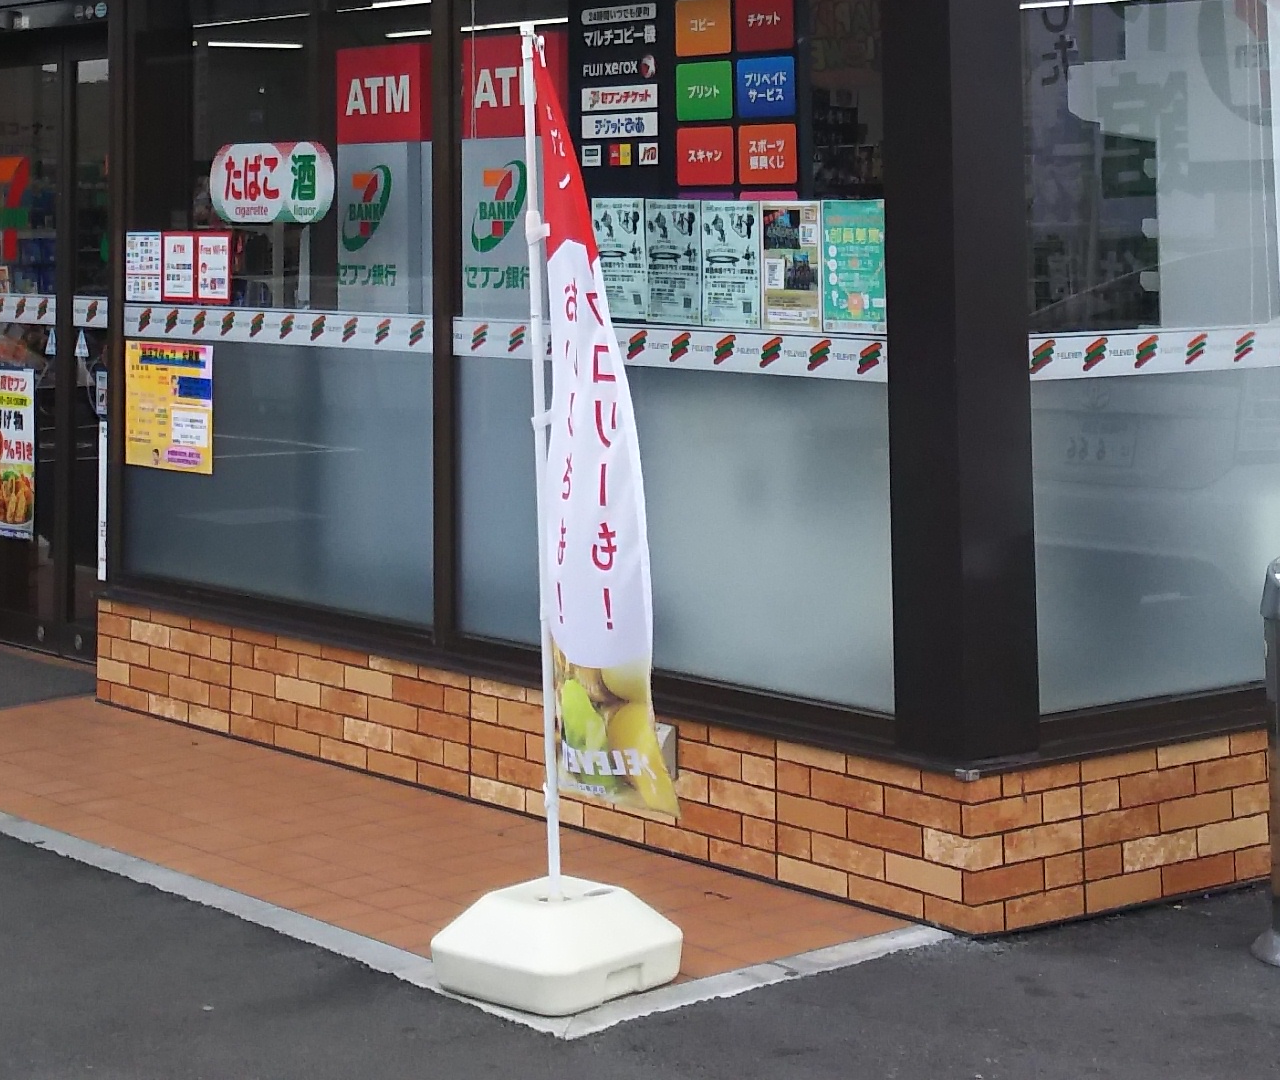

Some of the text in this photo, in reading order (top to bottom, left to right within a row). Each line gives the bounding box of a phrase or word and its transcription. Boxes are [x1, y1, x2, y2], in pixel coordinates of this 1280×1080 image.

[690, 18, 715, 32] コピー
[747, 12, 781, 27] チケット
[583, 24, 657, 47] マルチコピー機
[583, 63, 603, 77] FUJI
[744, 70, 787, 87] プリペイド
[345, 74, 410, 115] ATM
[601, 89, 651, 104] セブンチケット
[687, 84, 720, 99] プリント
[748, 88, 785, 102] サービス
[595, 117, 645, 135] チケットぴあ
[748, 139, 785, 153] スポーツ
[687, 148, 723, 163] スキャン
[224, 153, 317, 203] たばこ 酒
[234, 204, 318, 219] cigarette liquor
[349, 201, 381, 221] BANK
[479, 200, 517, 220] BANK
[337, 263, 398, 287] セブン銀行
